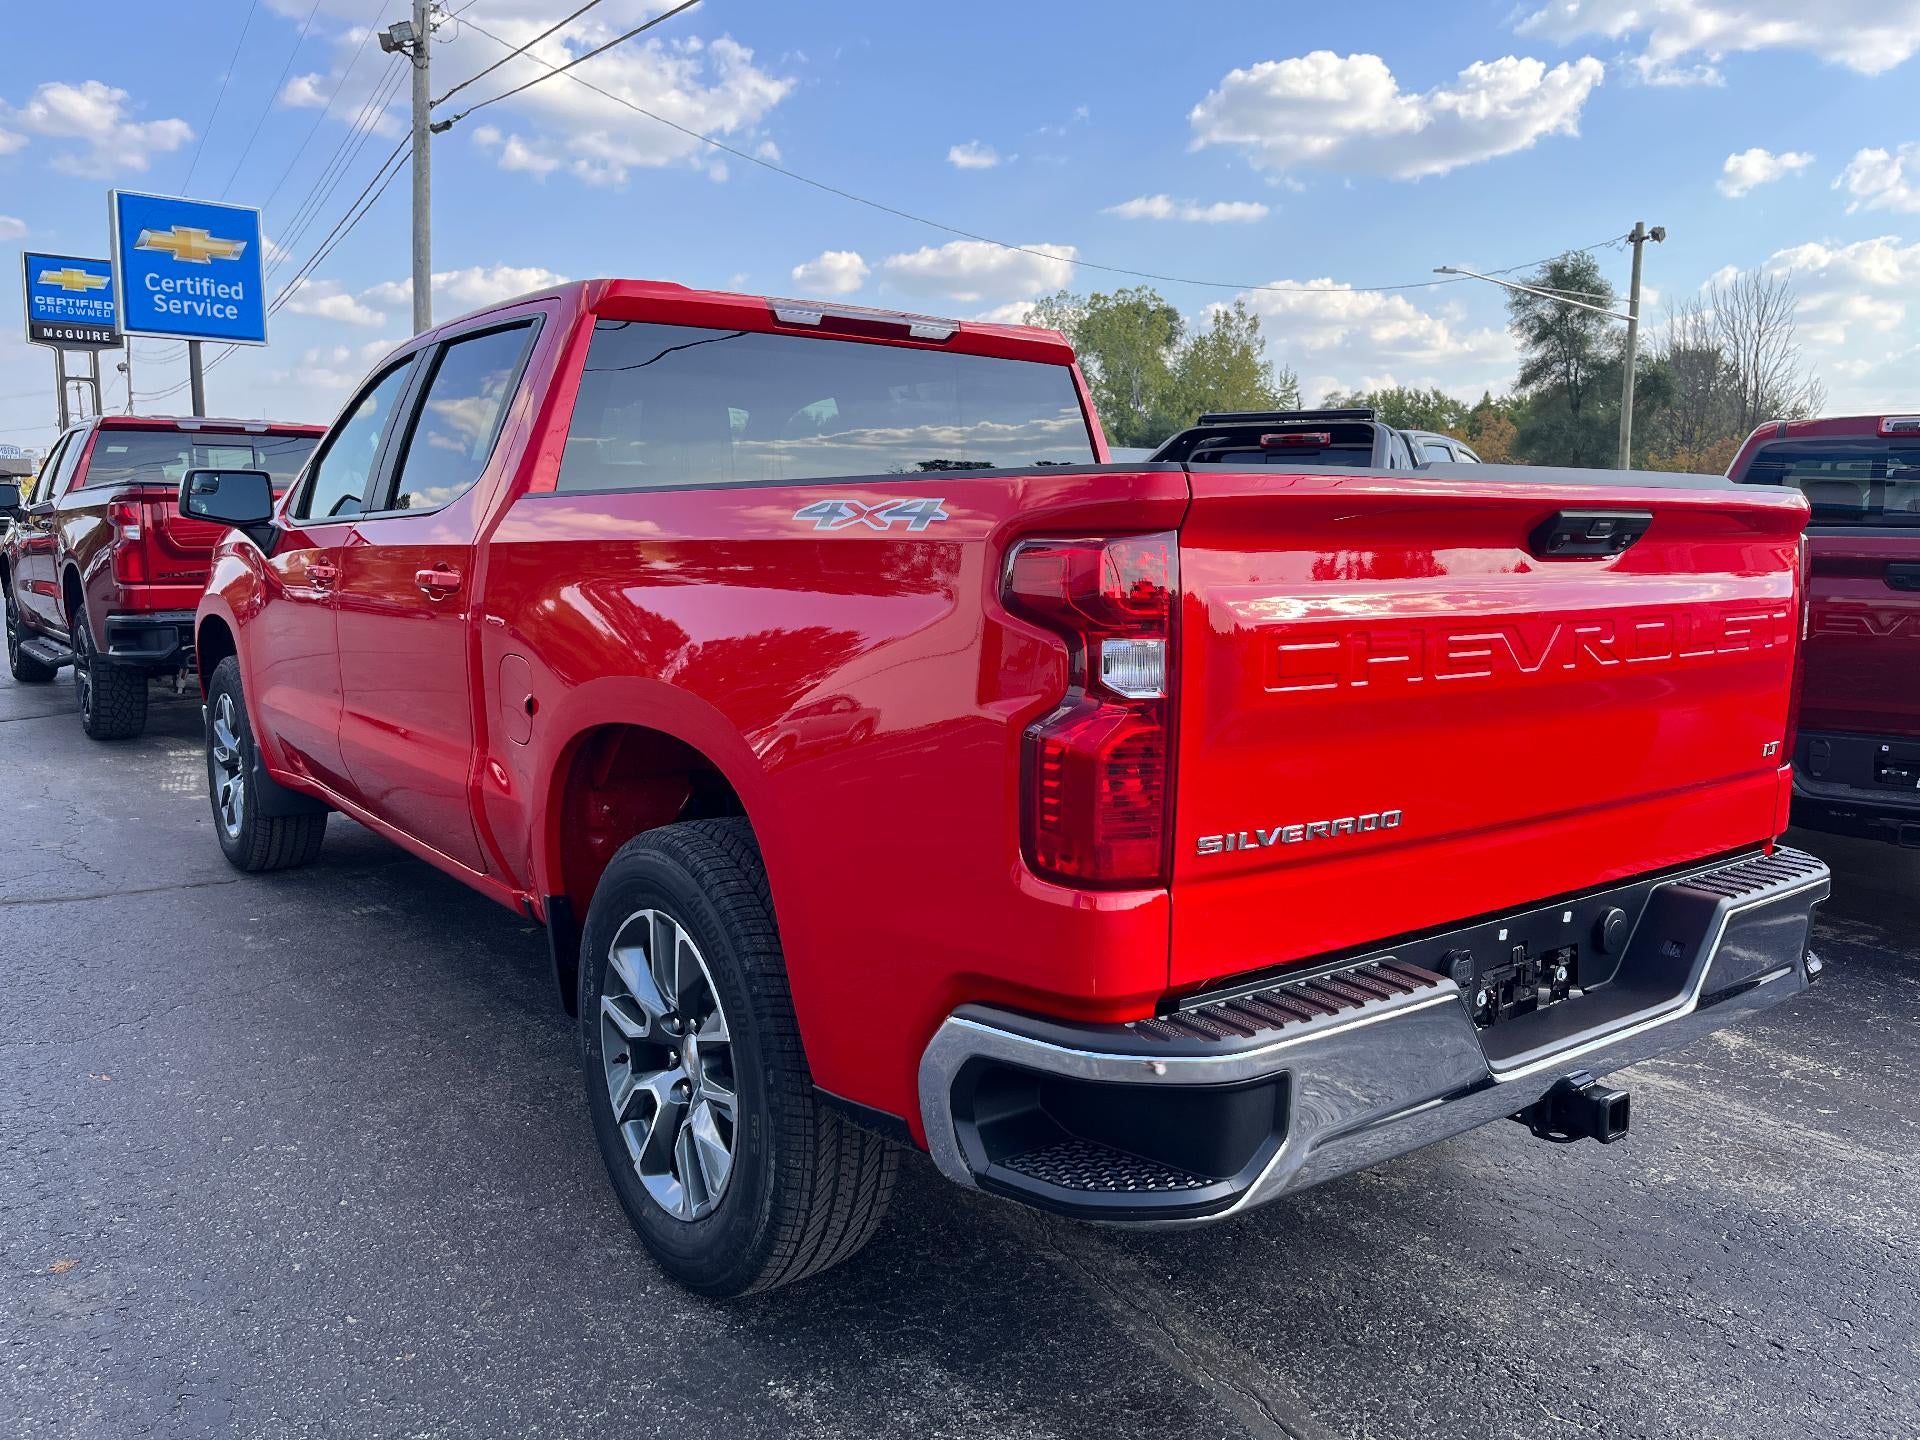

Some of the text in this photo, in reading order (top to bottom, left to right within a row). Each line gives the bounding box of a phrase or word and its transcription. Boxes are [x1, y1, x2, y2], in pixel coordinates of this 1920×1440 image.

[145, 272, 244, 300] Certified
[34, 296, 114, 310] CERTIFIED
[39, 305, 111, 318] PRE-OWNED
[153, 295, 238, 320] Service
[43, 328, 111, 341] McGUIRE
[1263, 606, 1789, 692] CHEVROLET
[1762, 740, 1780, 757] LT
[1197, 809, 1403, 856] SILVERADO
